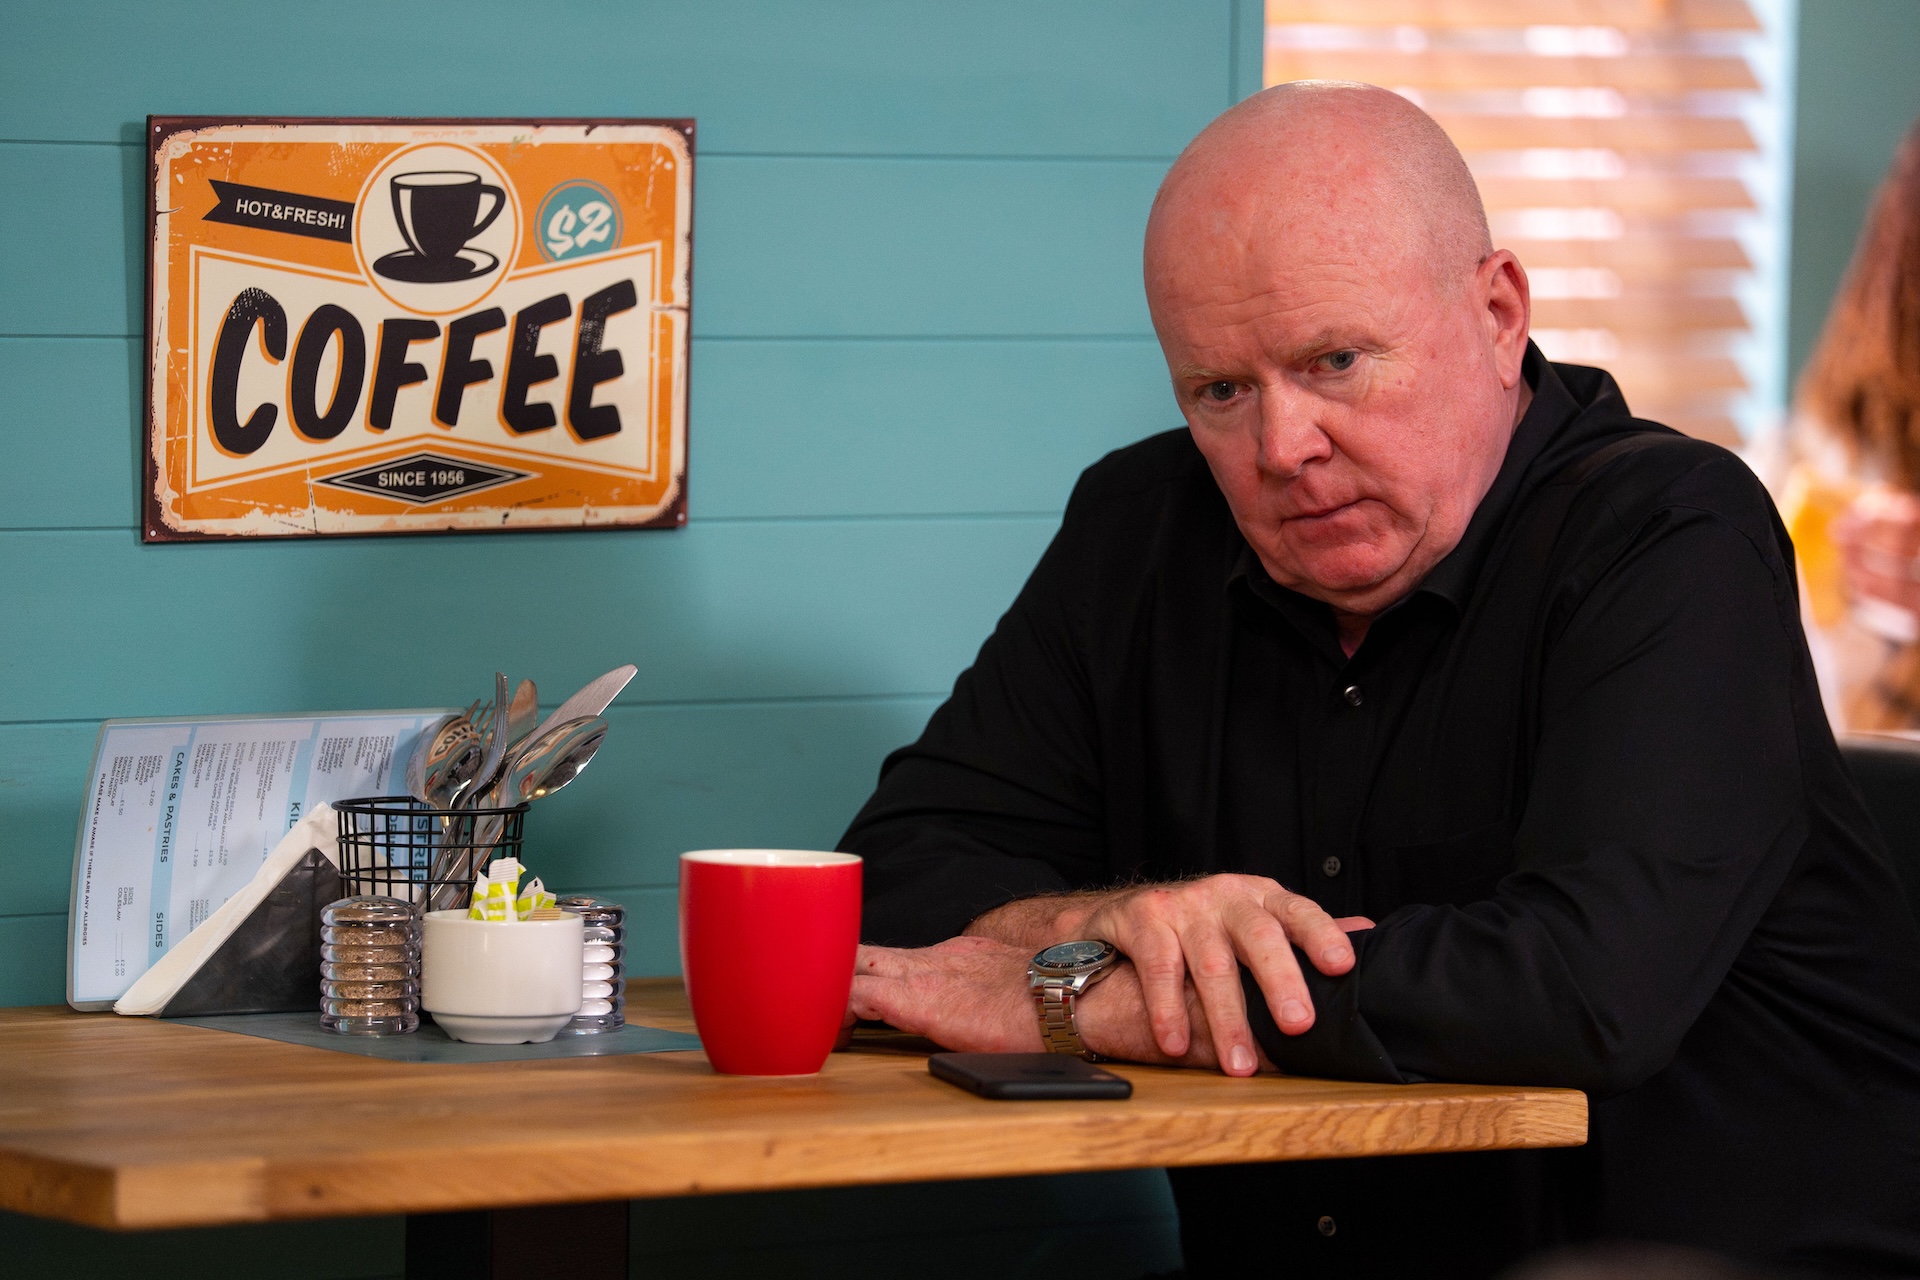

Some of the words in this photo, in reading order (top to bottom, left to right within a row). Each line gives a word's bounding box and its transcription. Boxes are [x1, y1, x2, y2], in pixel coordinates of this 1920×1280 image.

[236, 199, 346, 229] HOT&FRESH!
[547, 201, 612, 258] $2
[208, 279, 637, 456] COFFEE
[378, 471, 426, 487] SINCE
[430, 470, 465, 486] 1956
[97, 773, 107, 796] PLEASE
[171, 752, 185, 789] CAKES
[160, 805, 174, 863] PASTRIES
[414, 818, 429, 890] STREE
[155, 912, 164, 948] SIDES
